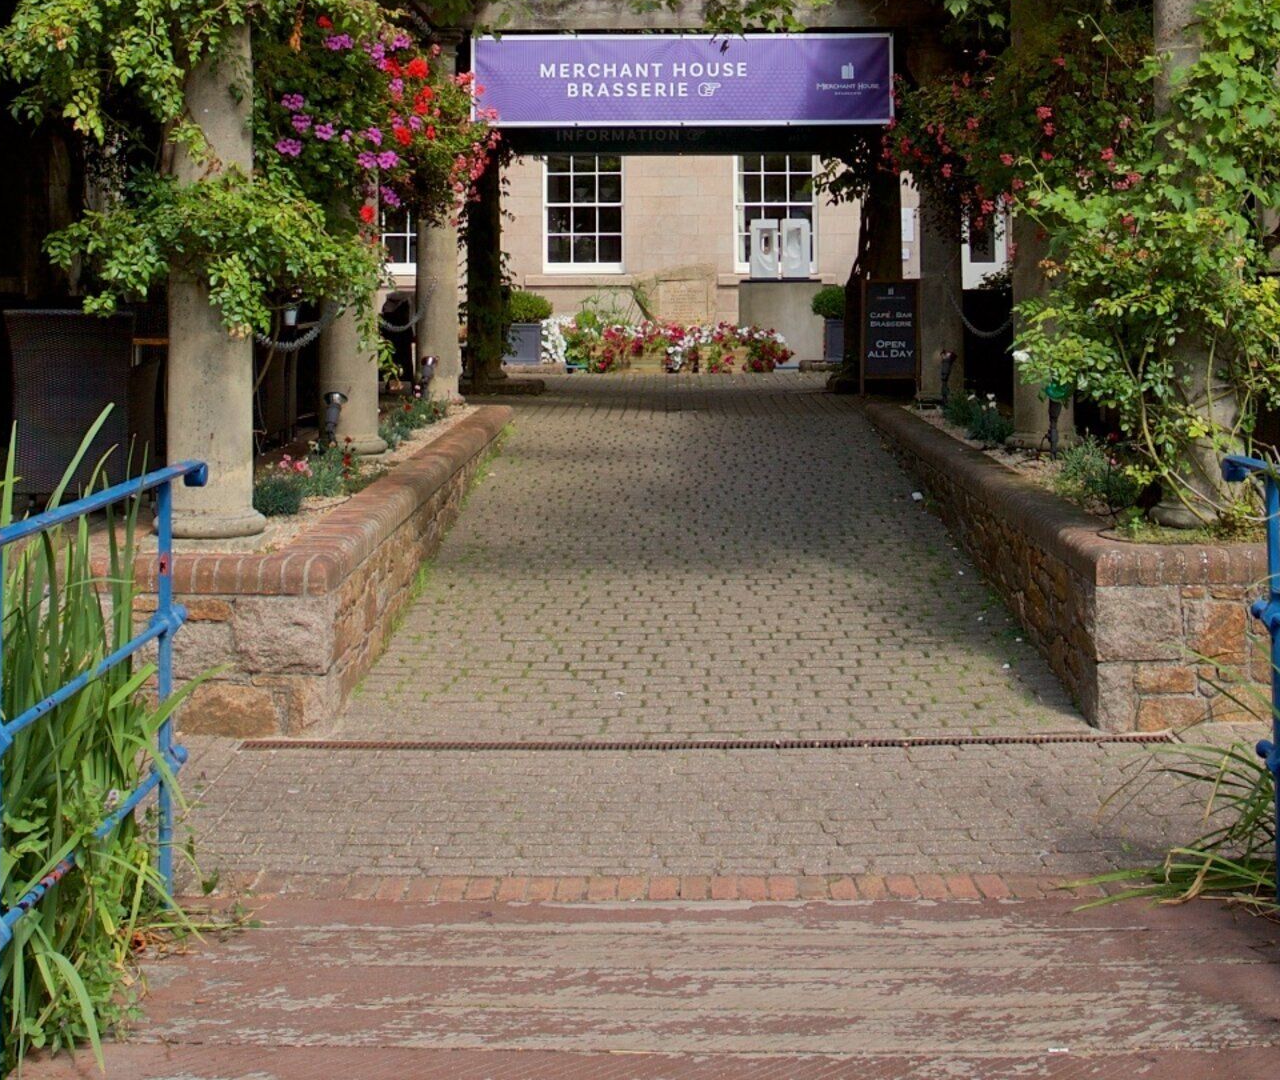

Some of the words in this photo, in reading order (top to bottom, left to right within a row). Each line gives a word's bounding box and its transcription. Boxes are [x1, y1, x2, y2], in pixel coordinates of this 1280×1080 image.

[539, 63, 664, 78] MERCHANT
[673, 62, 748, 77] HOUSE
[567, 82, 689, 97] BRASSERIE
[555, 128, 680, 142] INFORMATION
[869, 320, 912, 328] BRASSERIE
[875, 339, 906, 349] OPEN
[867, 350, 889, 358] ALL
[890, 348, 914, 358] DAY
